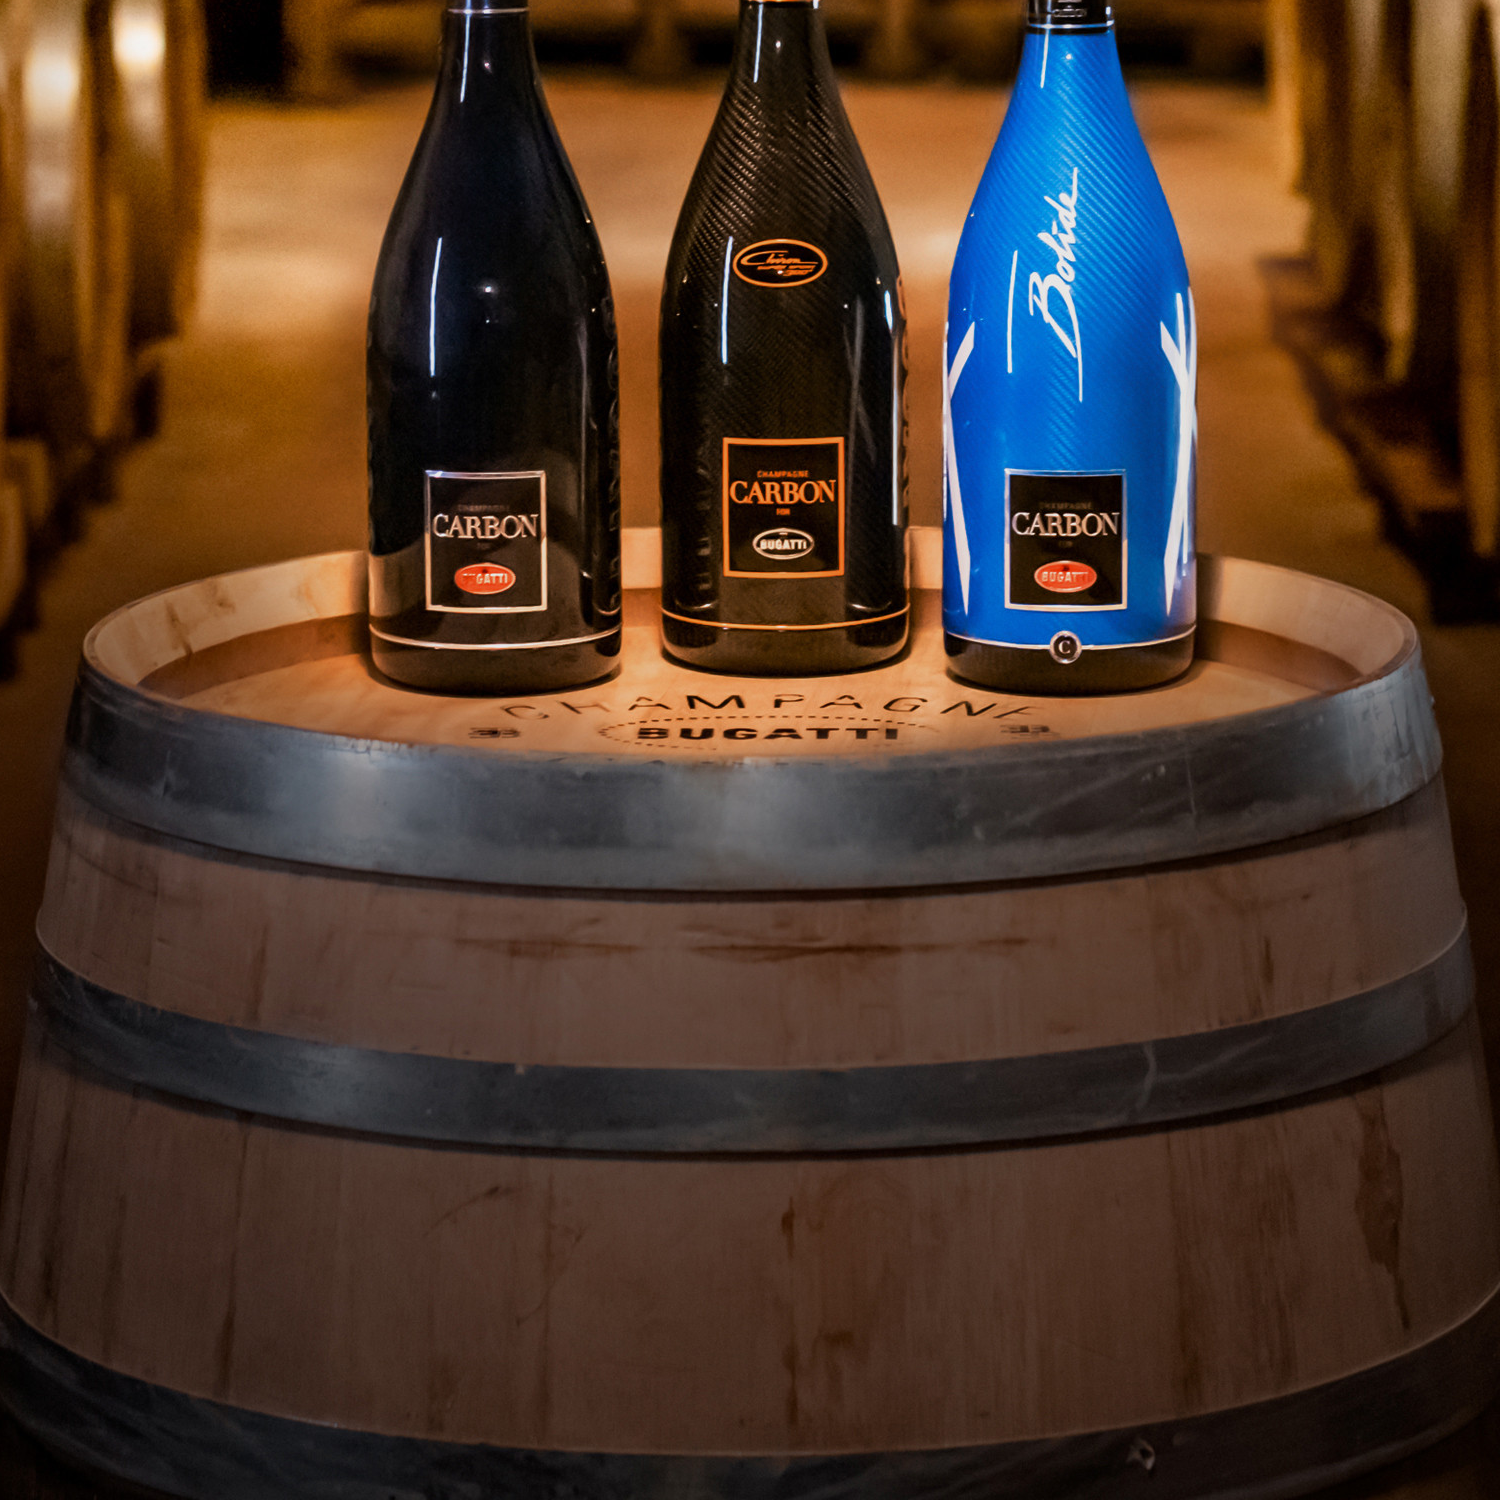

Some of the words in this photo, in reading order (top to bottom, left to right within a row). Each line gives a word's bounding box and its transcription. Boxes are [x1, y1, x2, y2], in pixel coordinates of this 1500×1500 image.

[1029, 167, 1083, 402] Bolide
[757, 470, 809, 478] CHAMPAGNE
[729, 480, 836, 505] CARBON
[432, 513, 539, 539] CARBON
[1012, 511, 1121, 537] CARBON
[760, 539, 807, 550] BUGATTI
[1058, 640, 1071, 654] C
[501, 694, 1045, 720] CHAMPAGNE
[637, 728, 898, 740] BUGATTI
